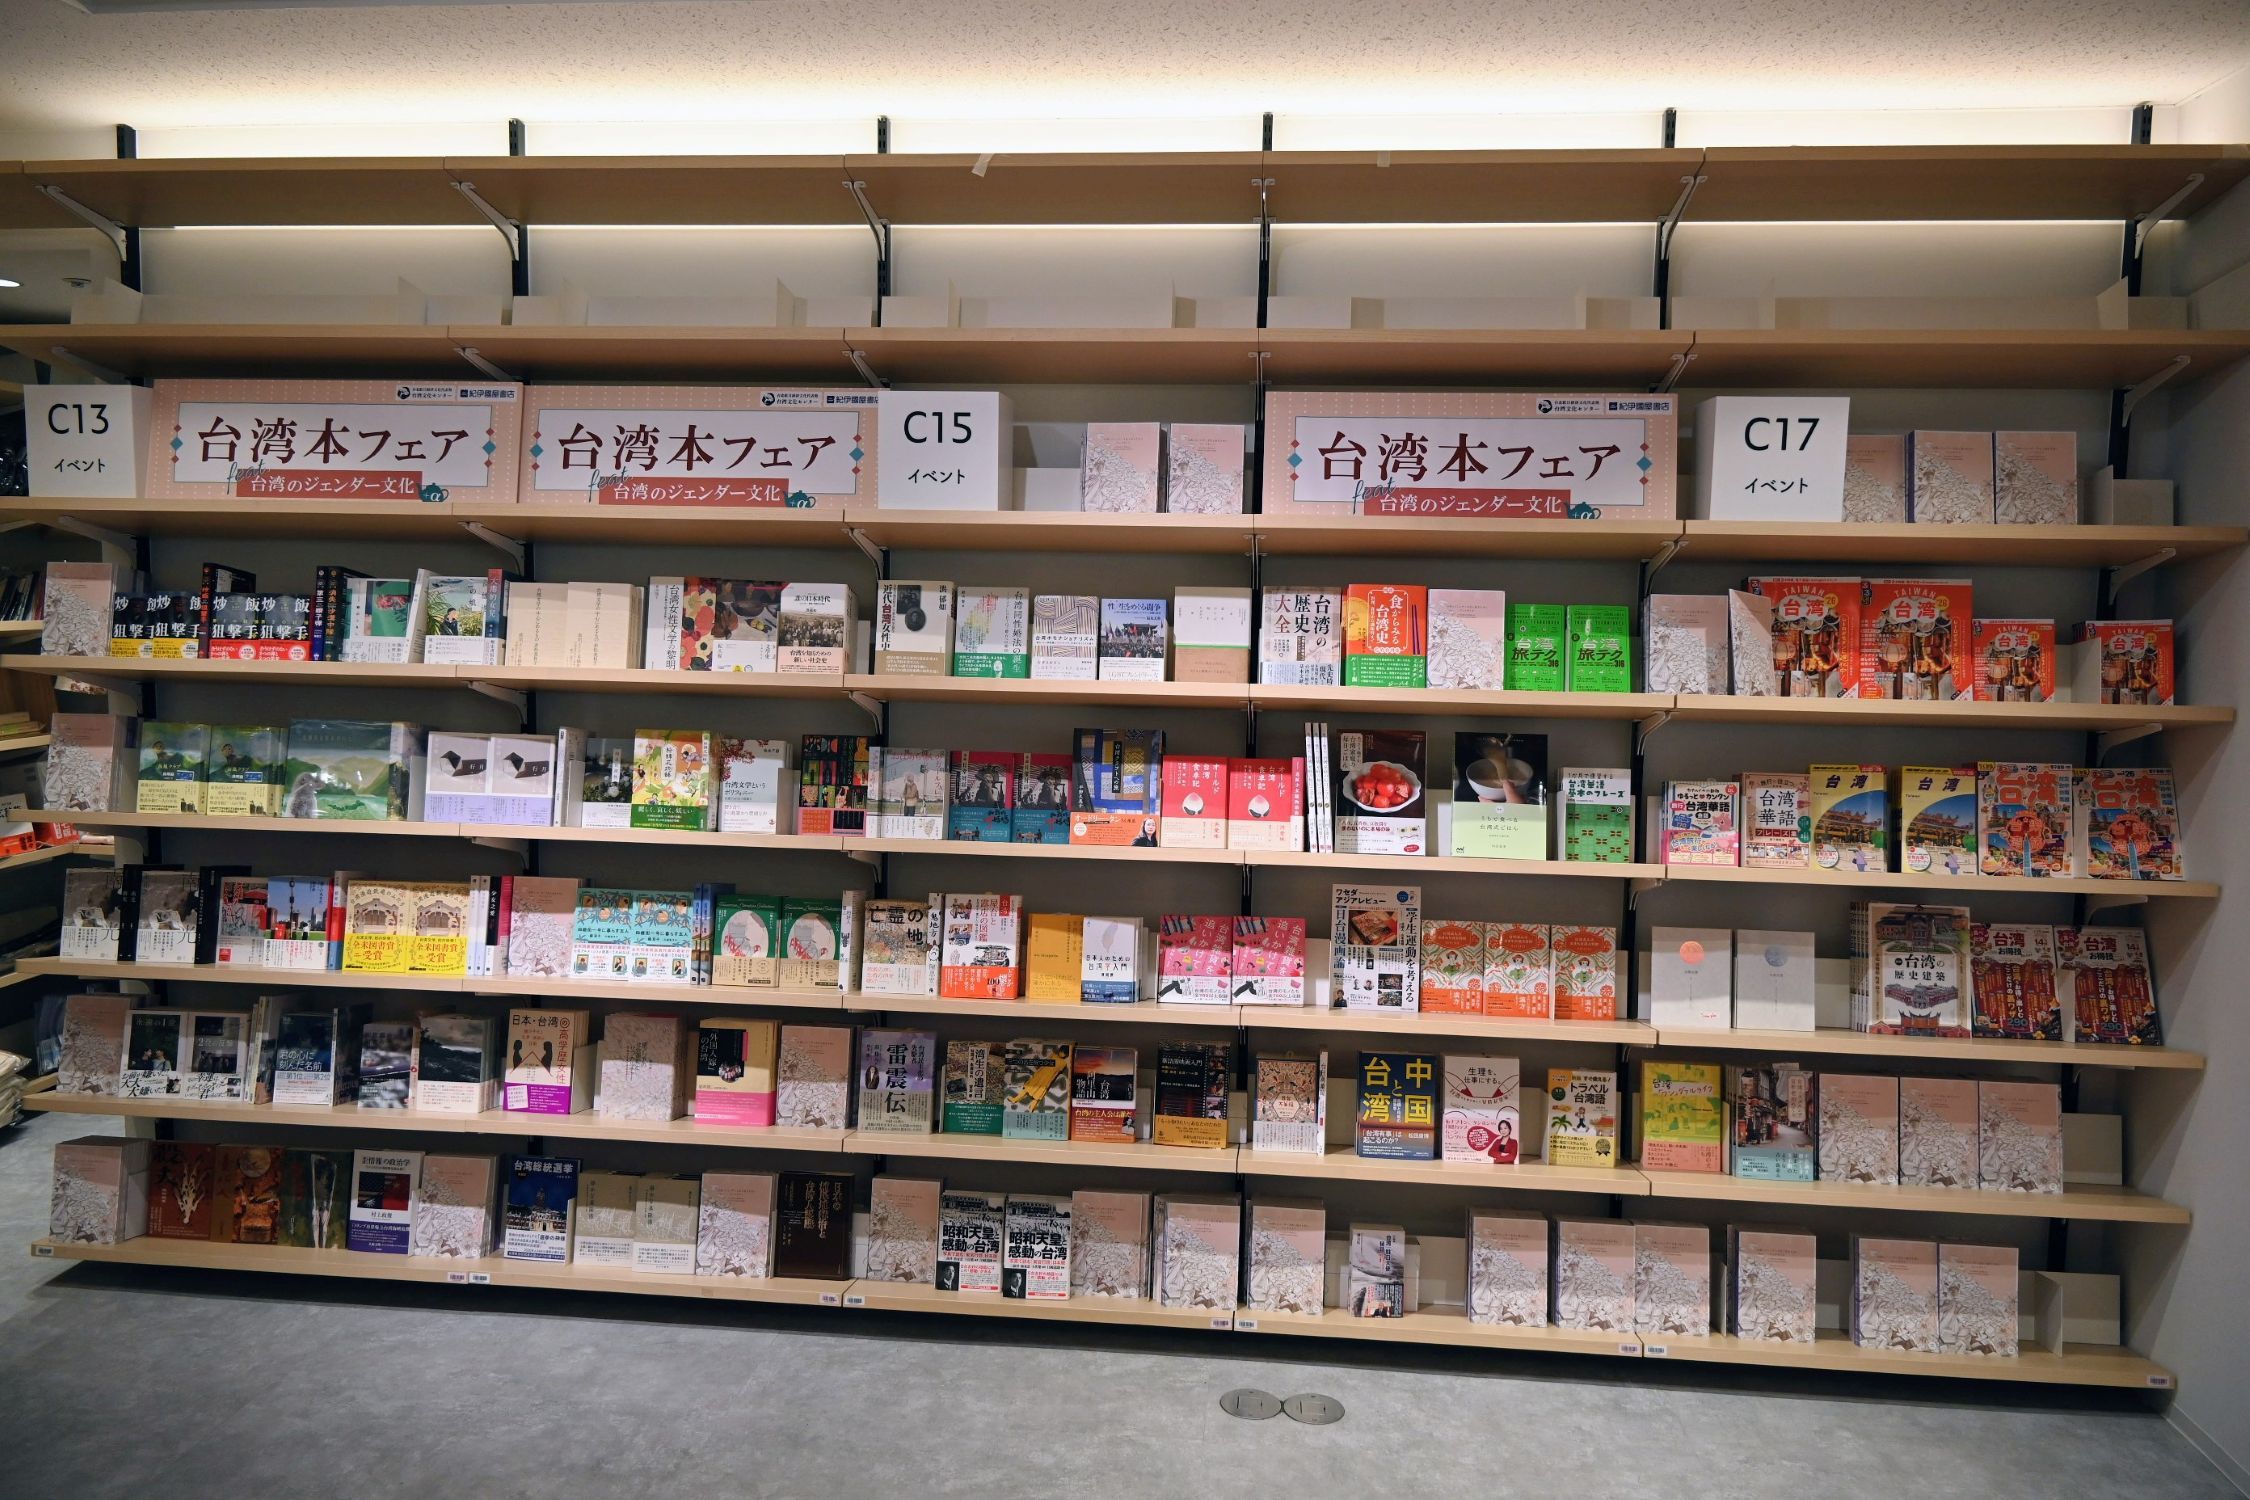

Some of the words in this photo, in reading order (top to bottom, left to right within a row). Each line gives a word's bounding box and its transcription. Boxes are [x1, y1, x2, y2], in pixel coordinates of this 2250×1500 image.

[47, 403, 109, 434] C13
[903, 411, 973, 445] C15
[1745, 417, 1820, 451] C17
[198, 416, 468, 464] 台湾本フェア
[558, 423, 837, 472] 台湾本フェア
[1318, 431, 1621, 482] 台湾本フェア
[54, 457, 106, 474] イベント
[251, 474, 415, 495] 台湾のジェンダー文化
[907, 467, 966, 485] イベント
[613, 483, 781, 502] 台湾のジェンダー文化
[1744, 477, 1809, 495] イベント
[1380, 494, 1561, 514] 台湾のジェンダー文化
[1783, 585, 1825, 597] TAIWAN
[1894, 587, 1937, 598] TAIWAN
[213, 596, 260, 612] 炒飯
[262, 596, 310, 613] 炒飯
[1783, 599, 1825, 618] 台湾
[1894, 601, 1937, 619] 台湾
[881, 584, 894, 652] 近代台湾女性史
[1273, 594, 1292, 635] 大全
[1294, 594, 1311, 634] 歴史
[1313, 594, 1332, 648] 台湾の
[155, 622, 201, 638] 狙撃手
[212, 624, 259, 639] 狙撃手
[260, 625, 309, 640] 狙撃手
[1375, 604, 1390, 645] 台湾史
[1997, 625, 2030, 633] TAIWAN
[2112, 628, 2146, 636] TAIWAN
[1998, 635, 2030, 648] 台湾
[2113, 637, 2146, 650] 台湾
[1512, 648, 1557, 661] 旅テク
[1577, 648, 1624, 661] 旅テク
[1202, 762, 1211, 780] 台湾
[1267, 766, 1276, 782] 台湾
[1825, 774, 1868, 789] 台湾
[1918, 777, 1960, 792] 台湾
[1568, 789, 1625, 798] 基本のフレーズ
[1759, 789, 1796, 808] 台湾
[1686, 801, 1730, 812] 台湾華語
[1758, 808, 1796, 827] 華語
[1335, 897, 1387, 905] アジアレビュー
[869, 906, 924, 924] 亡霊の
[906, 928, 924, 946] 地
[1333, 909, 1348, 969] 日台漫画論
[1993, 932, 2025, 948] 台湾
[2083, 936, 2117, 952] 台湾
[363, 950, 384, 961] 受賞
[427, 953, 448, 963] 受賞
[1405, 911, 1418, 1003] 学生運動を考える
[1904, 953, 1945, 970] 台湾の
[1894, 971, 1946, 982] 歴史建築
[556, 1029, 569, 1084] 高学歴女性
[279, 1061, 322, 1072] 刻んだ名前
[1468, 1067, 1497, 1076] 生理を、
[885, 1044, 909, 1114] 雷震伝
[1464, 1077, 1502, 1085] 仕事にする。
[1076, 1078, 1086, 1099] 物語
[1100, 1080, 1110, 1100] 台湾
[1362, 1056, 1391, 1123] 台湾
[1392, 1079, 1402, 1097] と
[1405, 1058, 1433, 1125] 中国
[1570, 1082, 1609, 1094] トラベル
[1574, 1093, 1606, 1104] 台湾語
[1362, 1130, 1402, 1138] 「台湾有事」は
[514, 1160, 574, 1174] 台湾総統選挙
[943, 1225, 1000, 1239] 昭和天皇と
[1009, 1232, 1067, 1246] 昭和天皇と
[942, 1239, 1000, 1254] 感動の台湾
[1008, 1246, 1068, 1260] 感動の台湾
